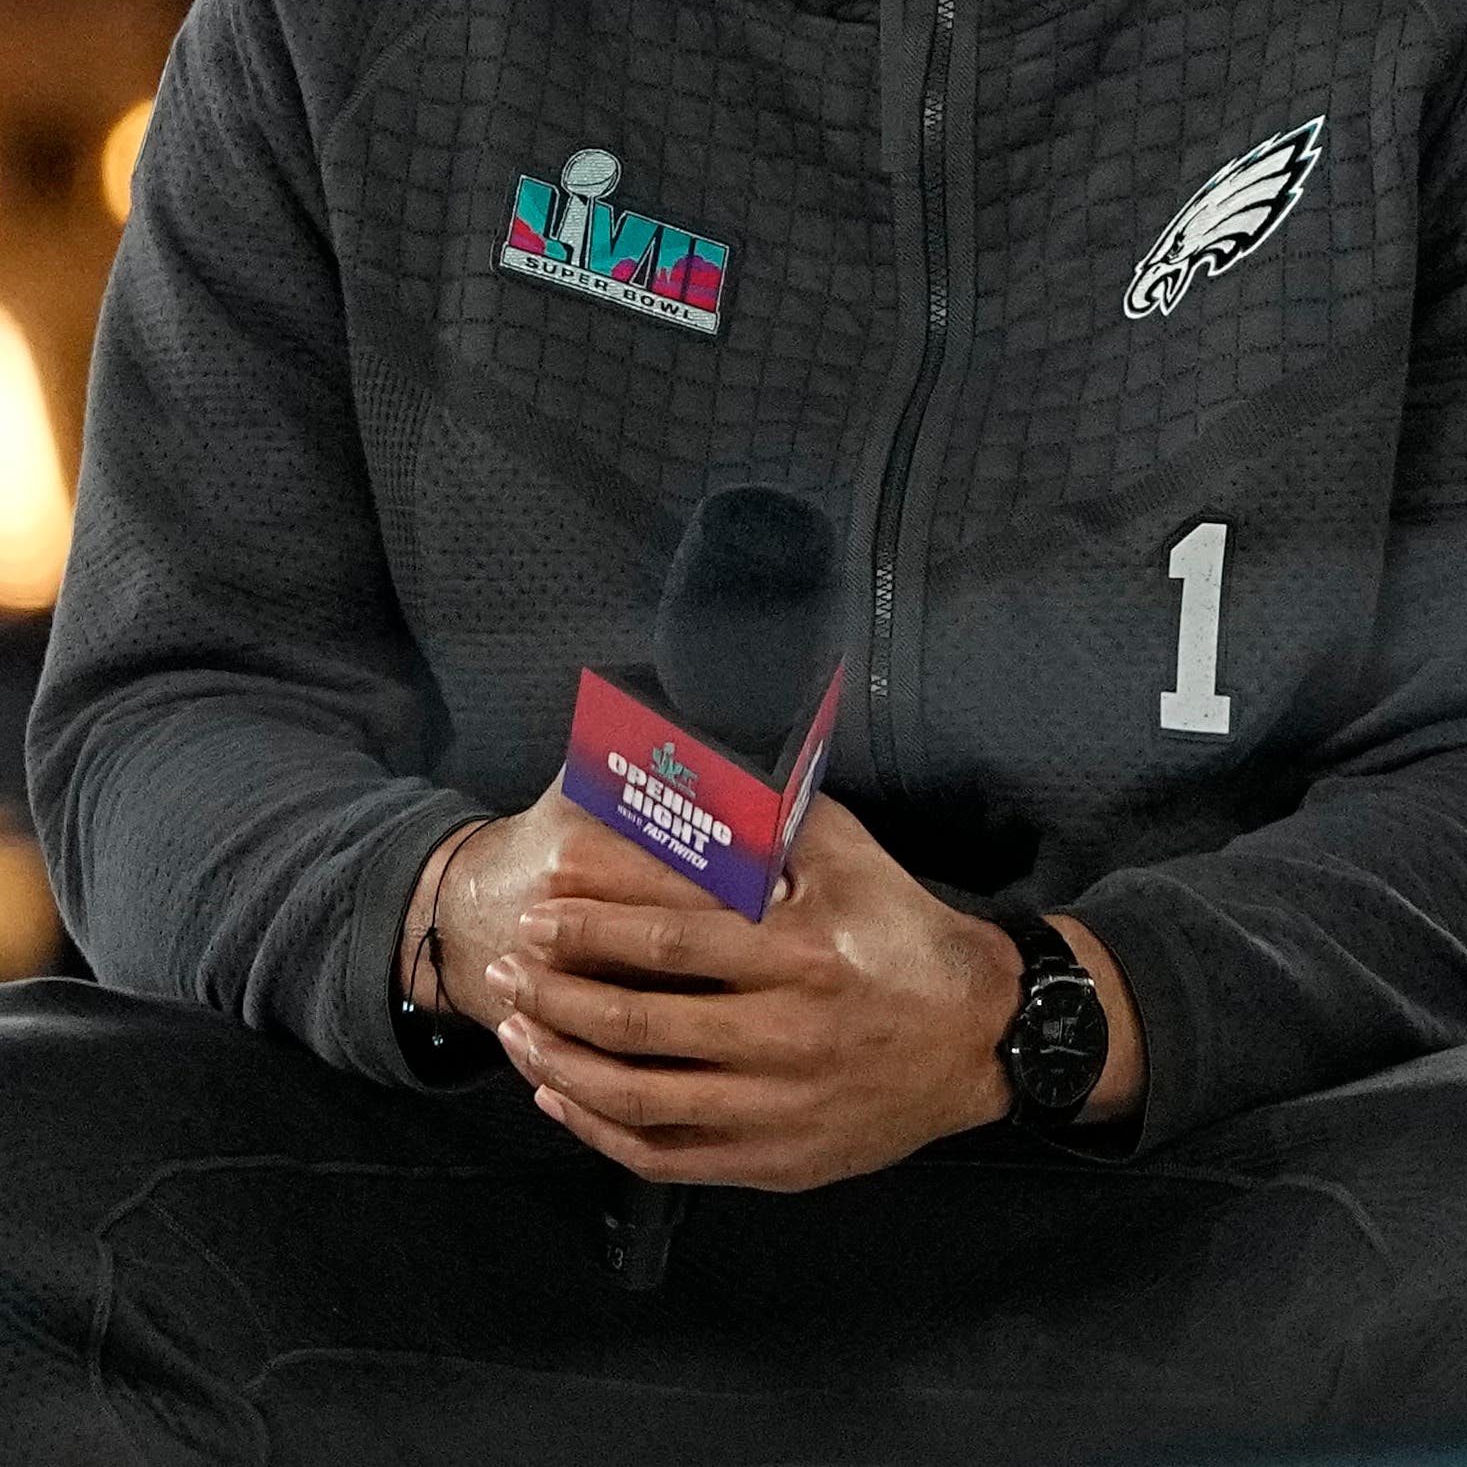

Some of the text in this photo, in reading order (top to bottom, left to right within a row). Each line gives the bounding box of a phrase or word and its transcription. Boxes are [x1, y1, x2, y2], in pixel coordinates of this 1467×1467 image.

[525, 256, 691, 320] SUPER BOWL
[1160, 522, 1231, 734] 1
[607, 751, 733, 846] OPENING
[622, 782, 710, 854] NIGHT
[642, 821, 708, 870] FAST TWITCH
